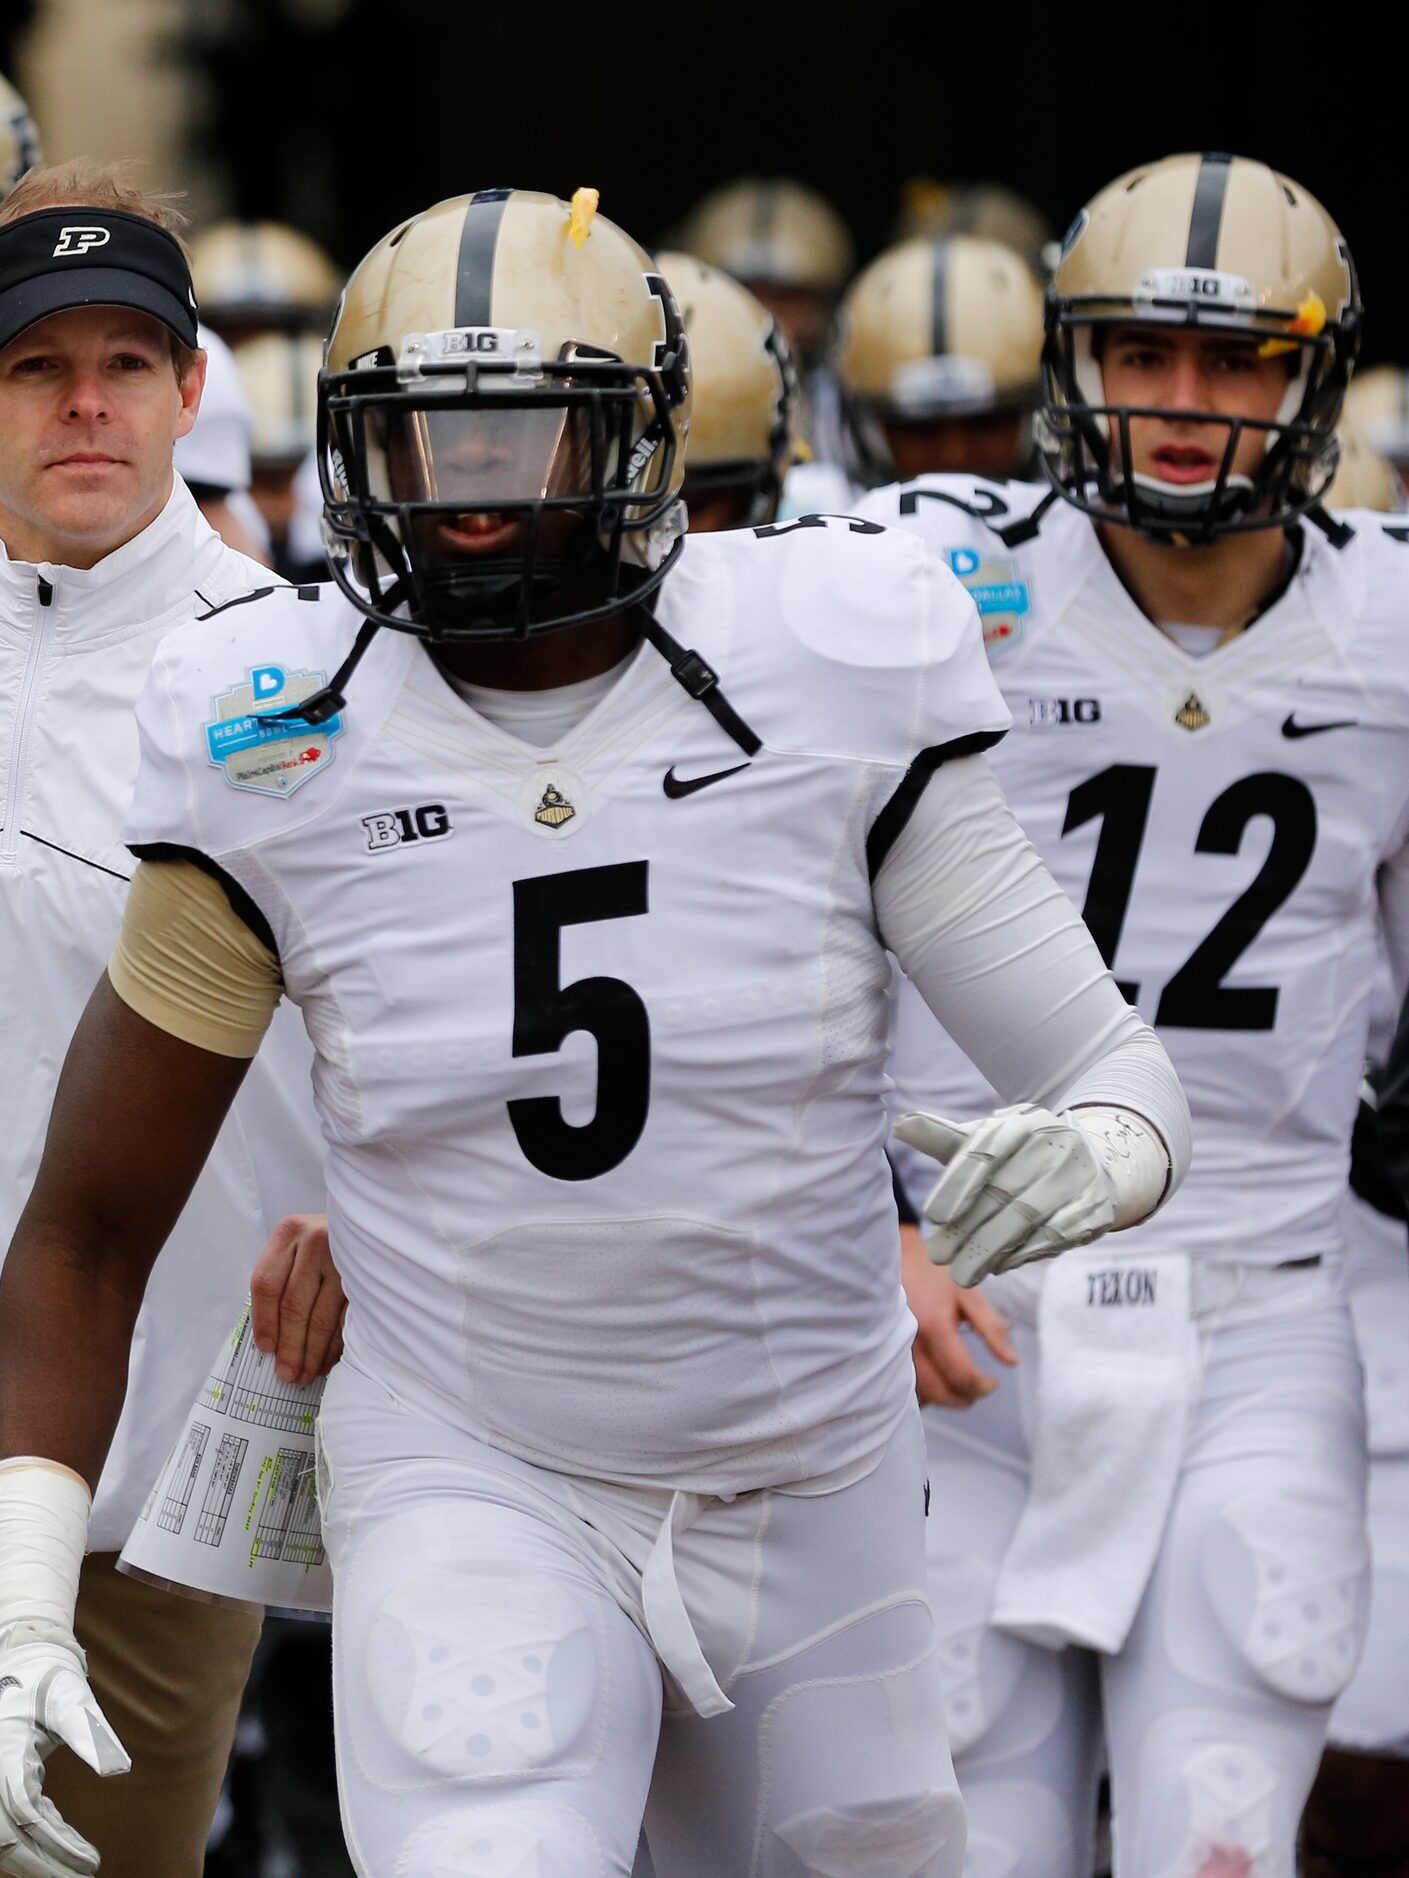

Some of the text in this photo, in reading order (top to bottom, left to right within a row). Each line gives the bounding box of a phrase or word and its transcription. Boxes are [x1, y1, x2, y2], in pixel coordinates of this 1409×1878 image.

[52, 226, 111, 258] P
[506, 860, 650, 1181] 5
[1060, 764, 1317, 1031] 12
